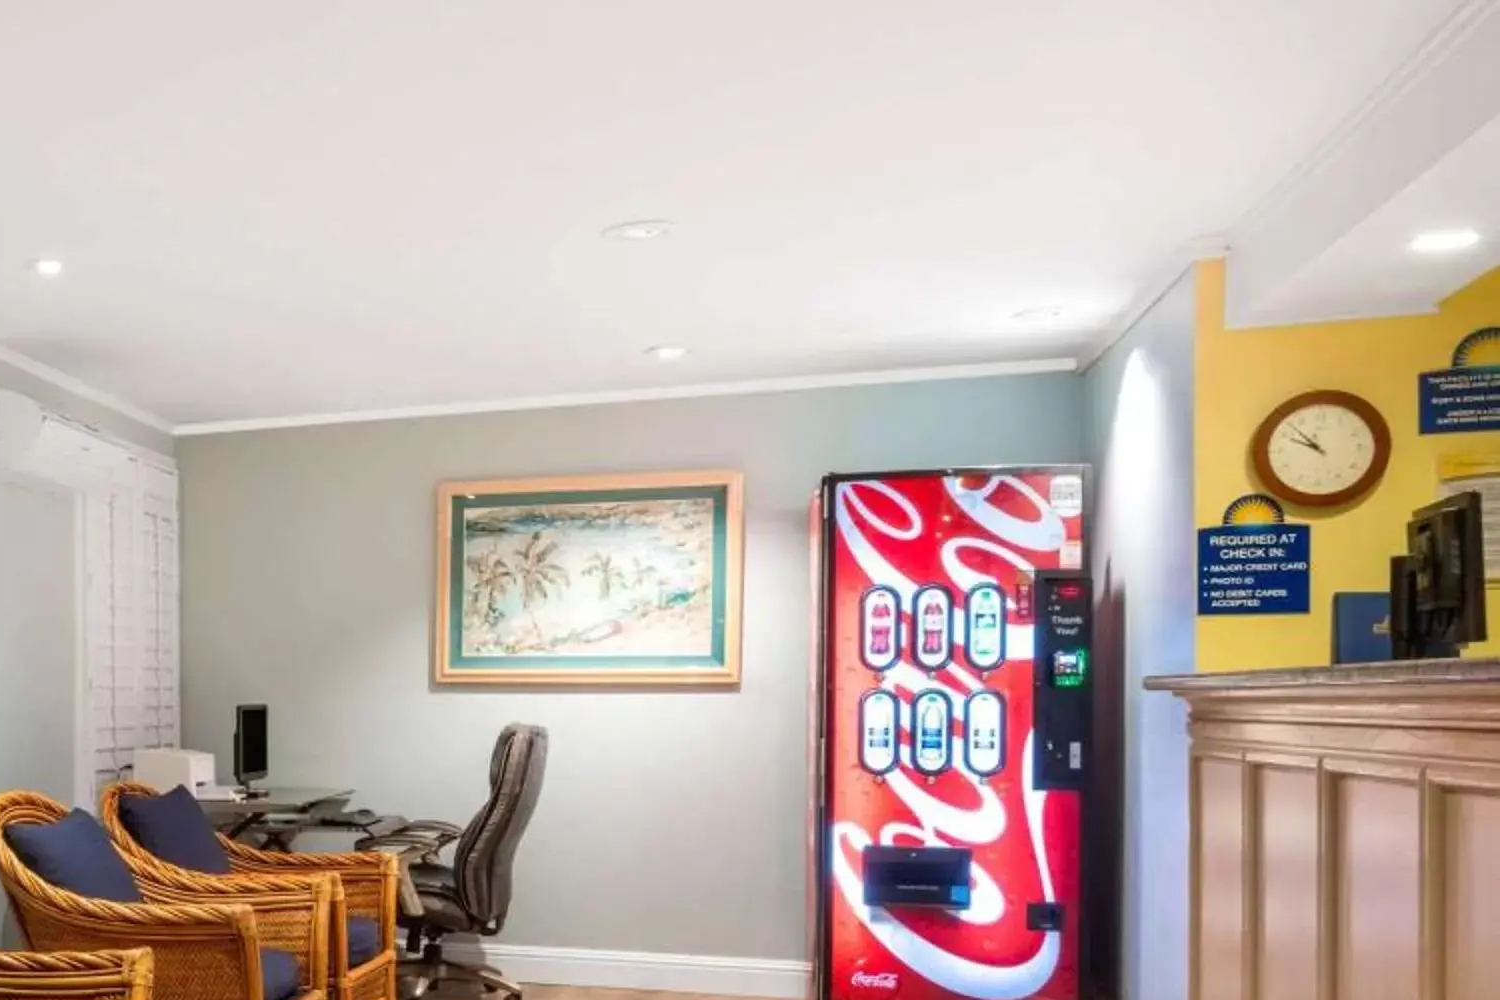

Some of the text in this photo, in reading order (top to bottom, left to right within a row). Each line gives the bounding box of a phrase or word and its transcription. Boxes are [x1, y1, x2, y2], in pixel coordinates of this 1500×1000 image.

[1209, 533, 1297, 546] REQUIRED AT
[1220, 547, 1266, 559] CHECK
[1209, 562, 1307, 573] MAJOR CREDIT CARD
[1210, 576, 1255, 585] PHOTO ID
[1210, 590, 1224, 599] NO
[1255, 589, 1288, 598] CARDS
[851, 970, 899, 989] Coca-Cola
